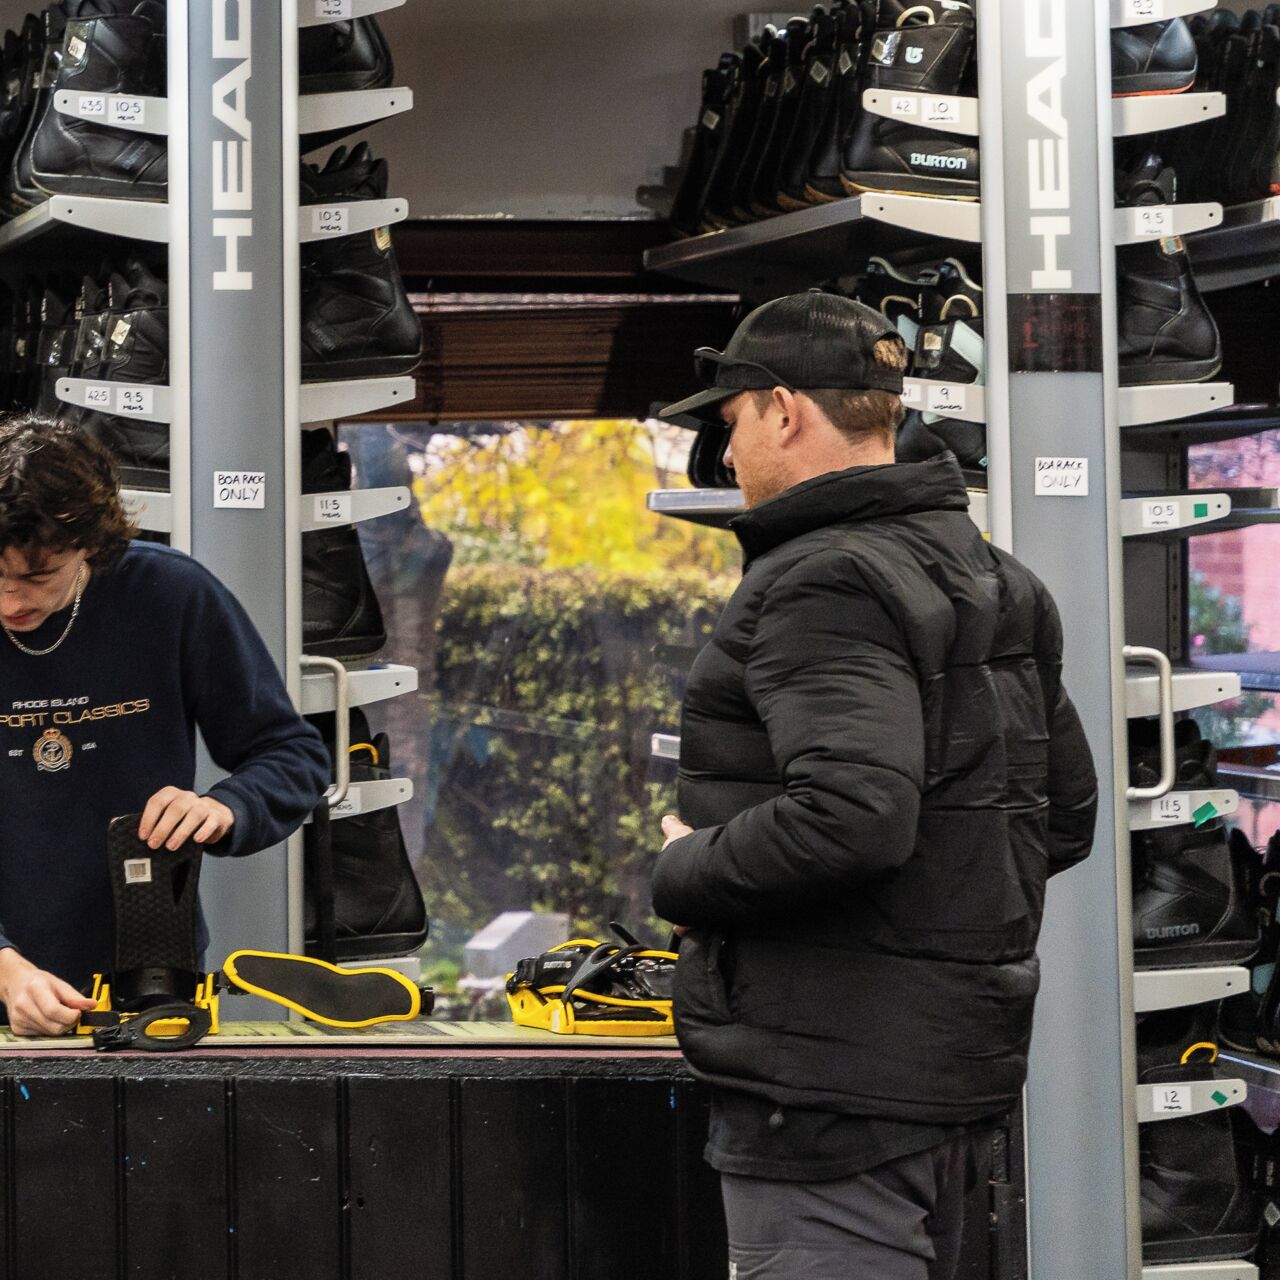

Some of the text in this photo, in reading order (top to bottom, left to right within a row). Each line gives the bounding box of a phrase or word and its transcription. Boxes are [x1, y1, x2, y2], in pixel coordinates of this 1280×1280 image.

[932, 102, 949, 114] 10
[910, 152, 968, 170] BURTON
[940, 386, 950, 401] 9
[1040, 474, 1082, 489] ONLY
[218, 487, 260, 502] ONLY
[11, 695, 90, 710] RHODE ISLAND
[52, 697, 151, 725] CLASSICS
[1144, 922, 1200, 940] BURTON
[1164, 1090, 1181, 1103] 12
